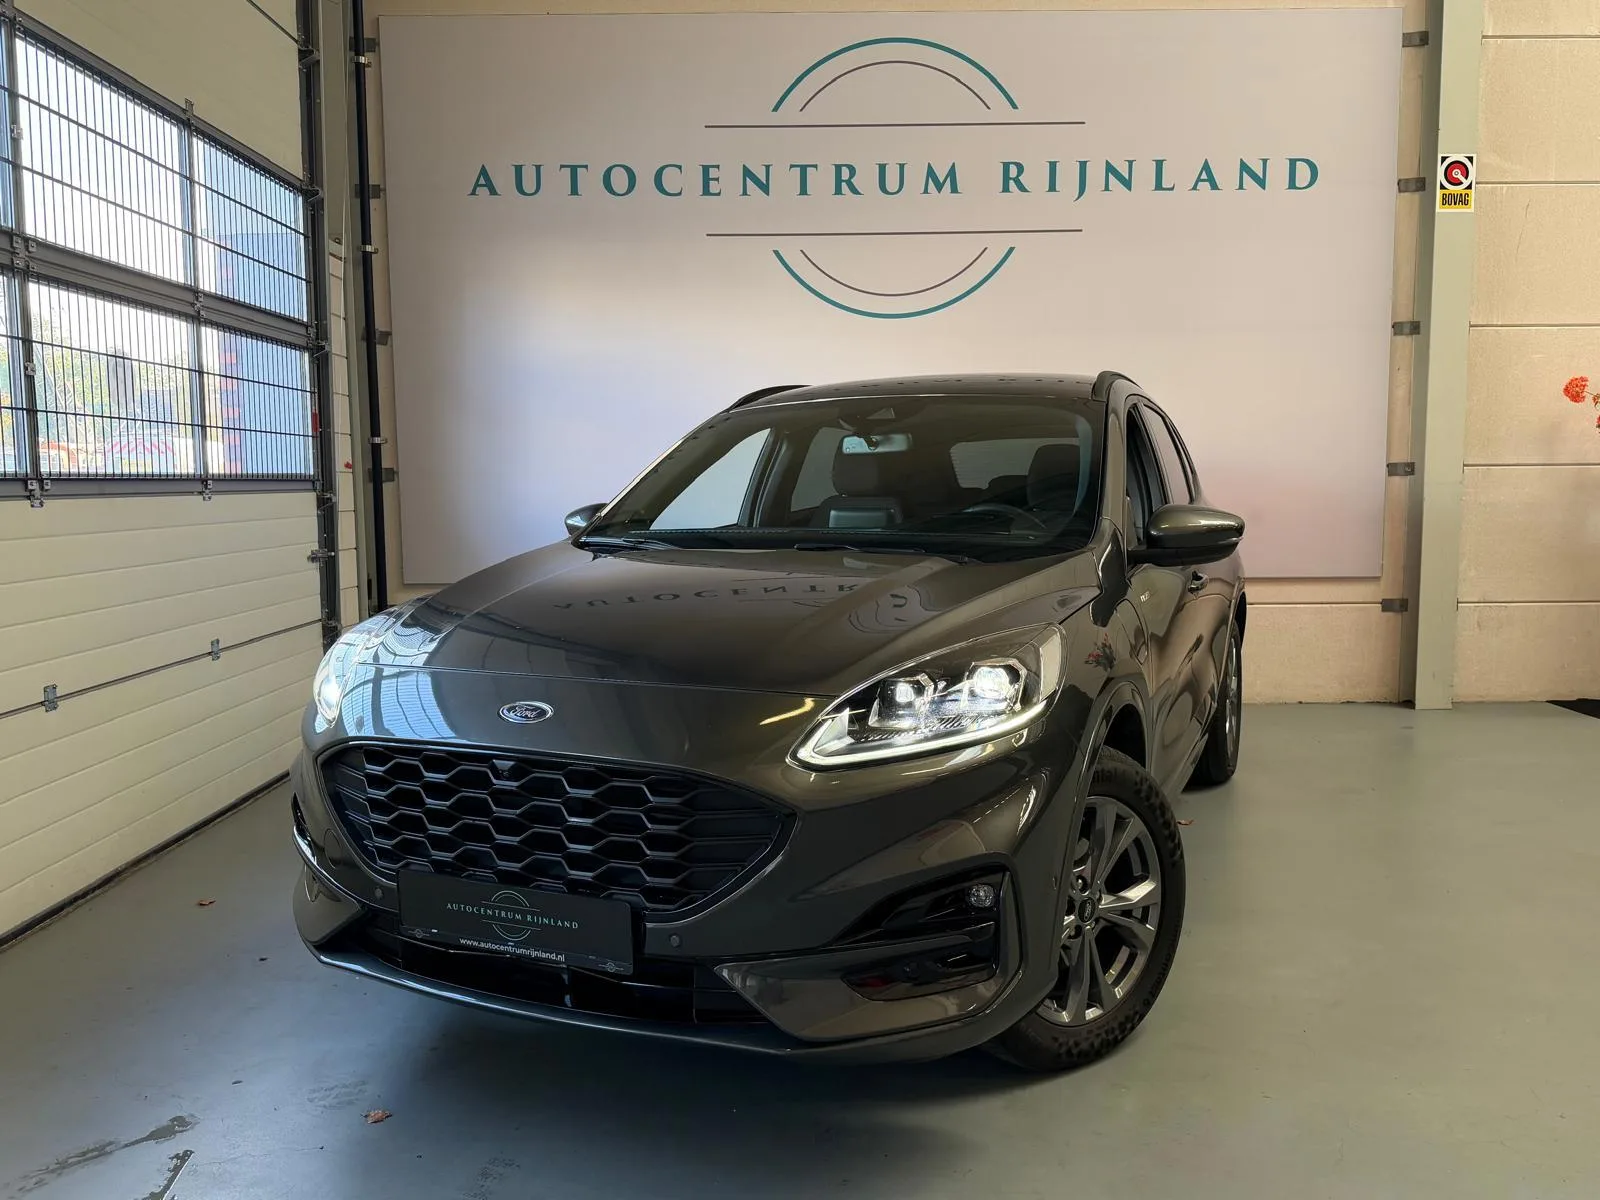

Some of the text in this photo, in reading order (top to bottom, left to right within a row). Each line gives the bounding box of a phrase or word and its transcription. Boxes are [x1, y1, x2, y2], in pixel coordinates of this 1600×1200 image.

[467, 158, 1319, 202] AUTOCENTRUM RIJNLAND
[1441, 192, 1470, 206] BOVAG
[446, 902, 579, 929] AUTOCENTRUM RIJNLAND
[459, 937, 565, 962] www.autocentrumrijnland.nl
